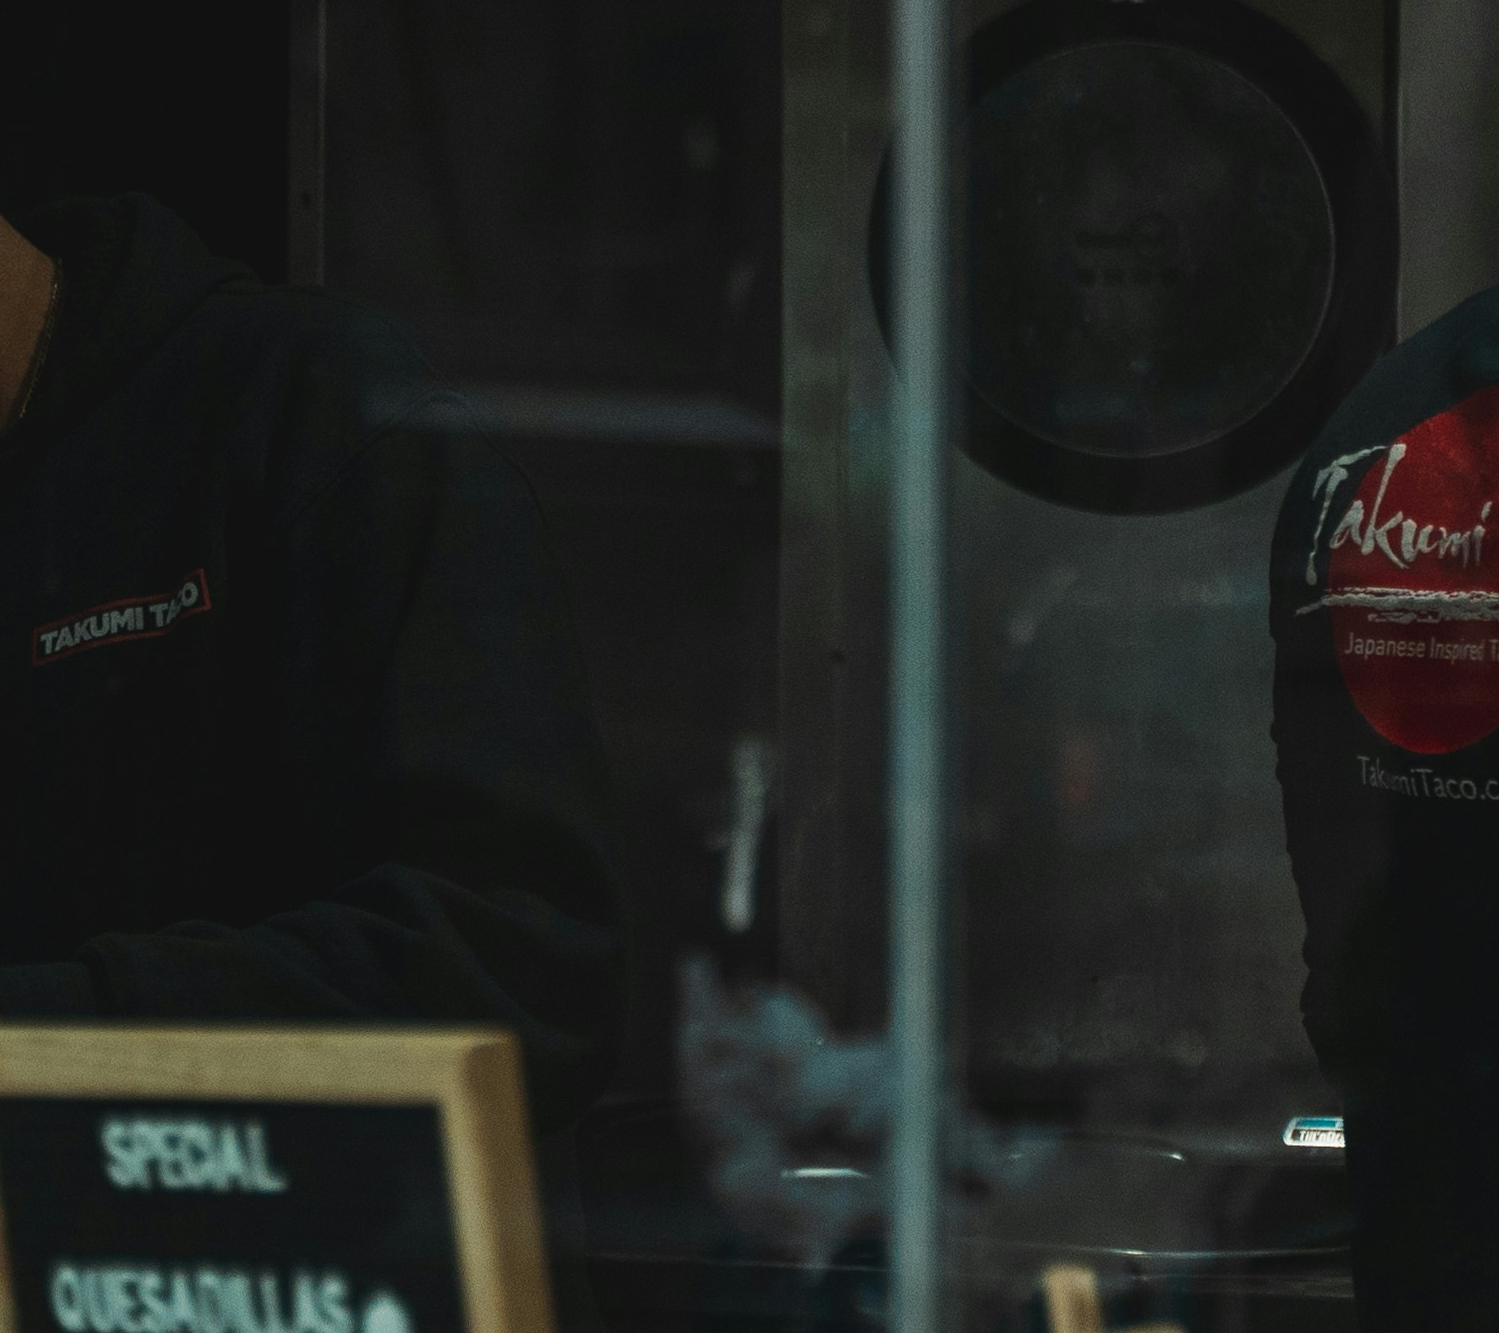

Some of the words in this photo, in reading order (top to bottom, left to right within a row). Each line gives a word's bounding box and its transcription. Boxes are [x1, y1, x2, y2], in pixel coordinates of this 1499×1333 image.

[1305, 442, 1493, 586] Takumi
[39, 606, 144, 656] TAKUMI
[1344, 631, 1426, 661] Japanese
[100, 1114, 290, 1195] SPECIAL
